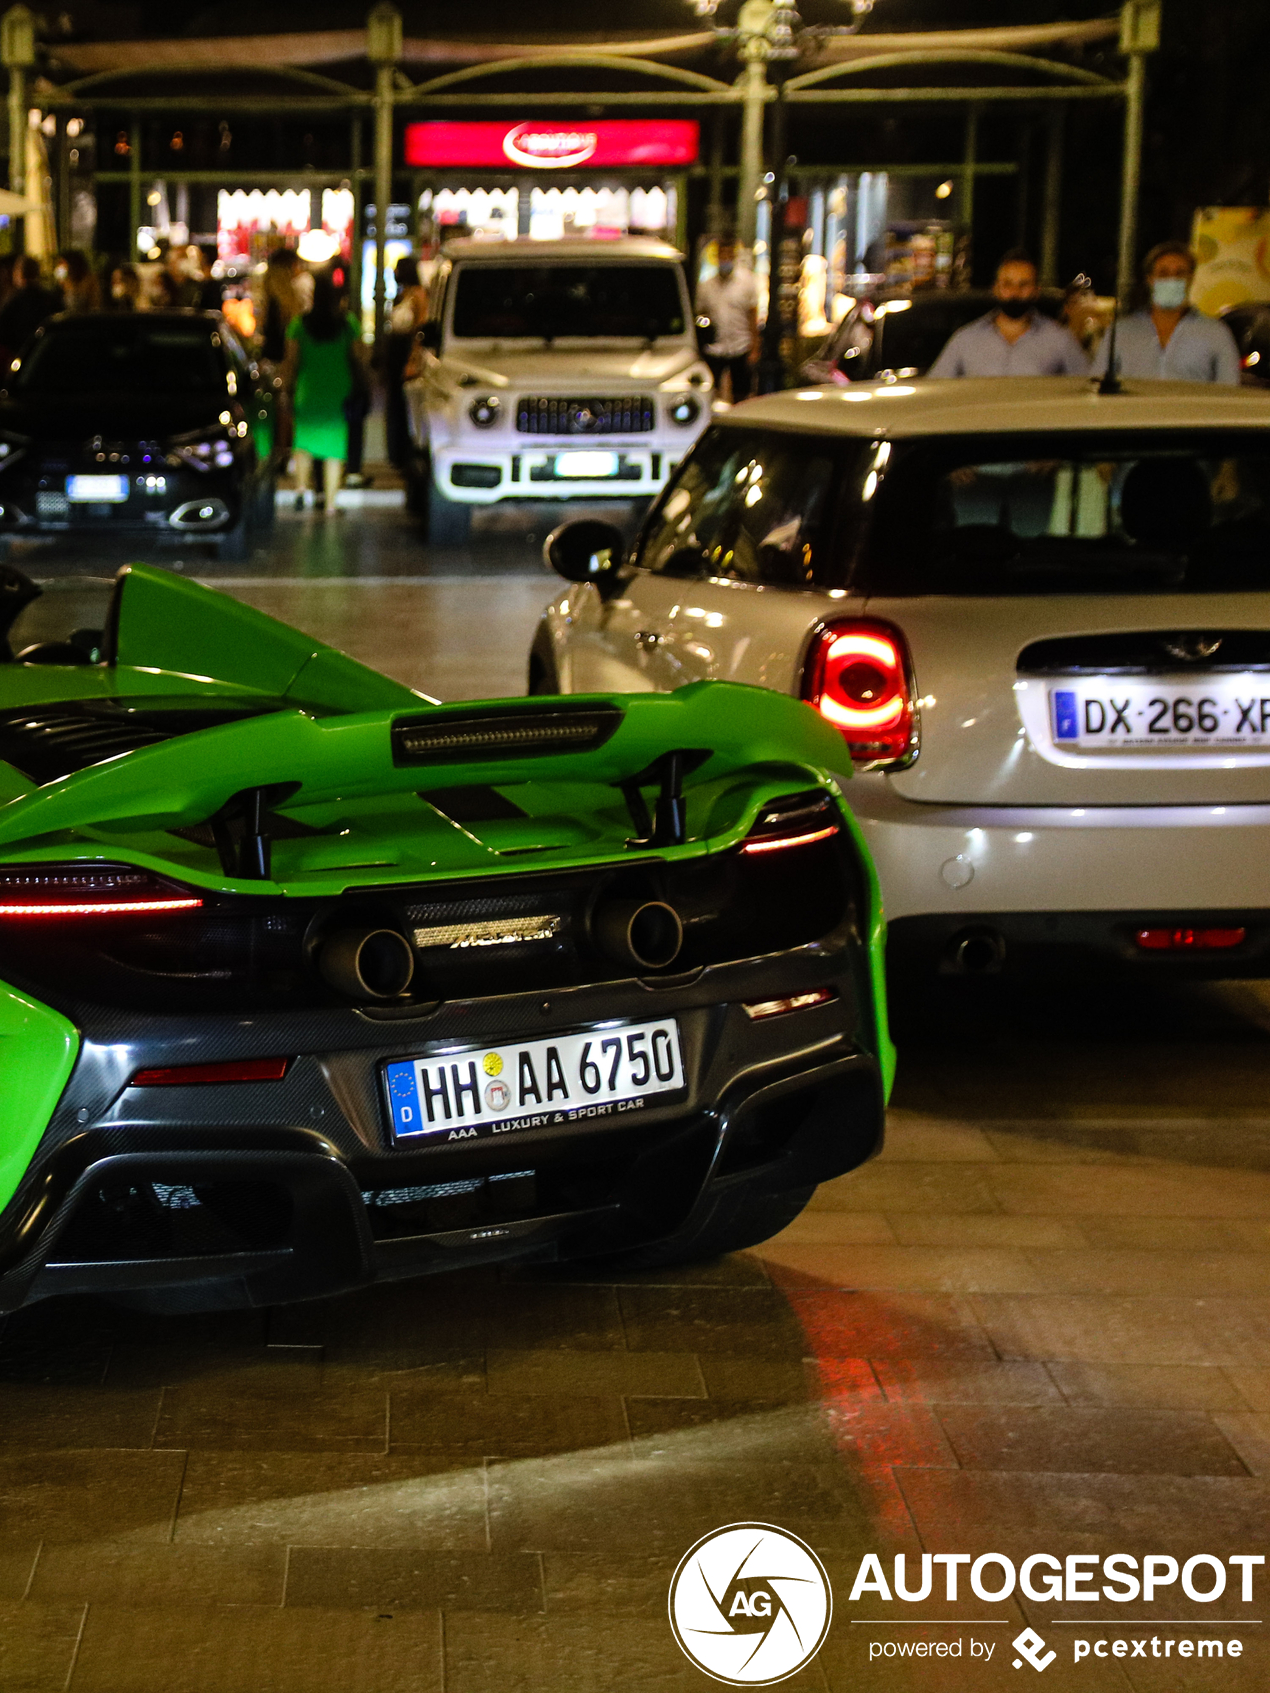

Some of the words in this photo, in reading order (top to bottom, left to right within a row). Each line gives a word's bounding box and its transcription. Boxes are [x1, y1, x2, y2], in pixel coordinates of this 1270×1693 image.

[420, 1061, 482, 1122] HH
[517, 1046, 569, 1106] AA
[579, 1029, 675, 1095] 6750
[400, 1106, 413, 1123] D
[447, 1127, 478, 1141] AAA
[491, 1114, 549, 1133] LUXURY
[553, 1112, 564, 1123] &
[568, 1103, 614, 1121] SPORT
[617, 1098, 644, 1113] CAR
